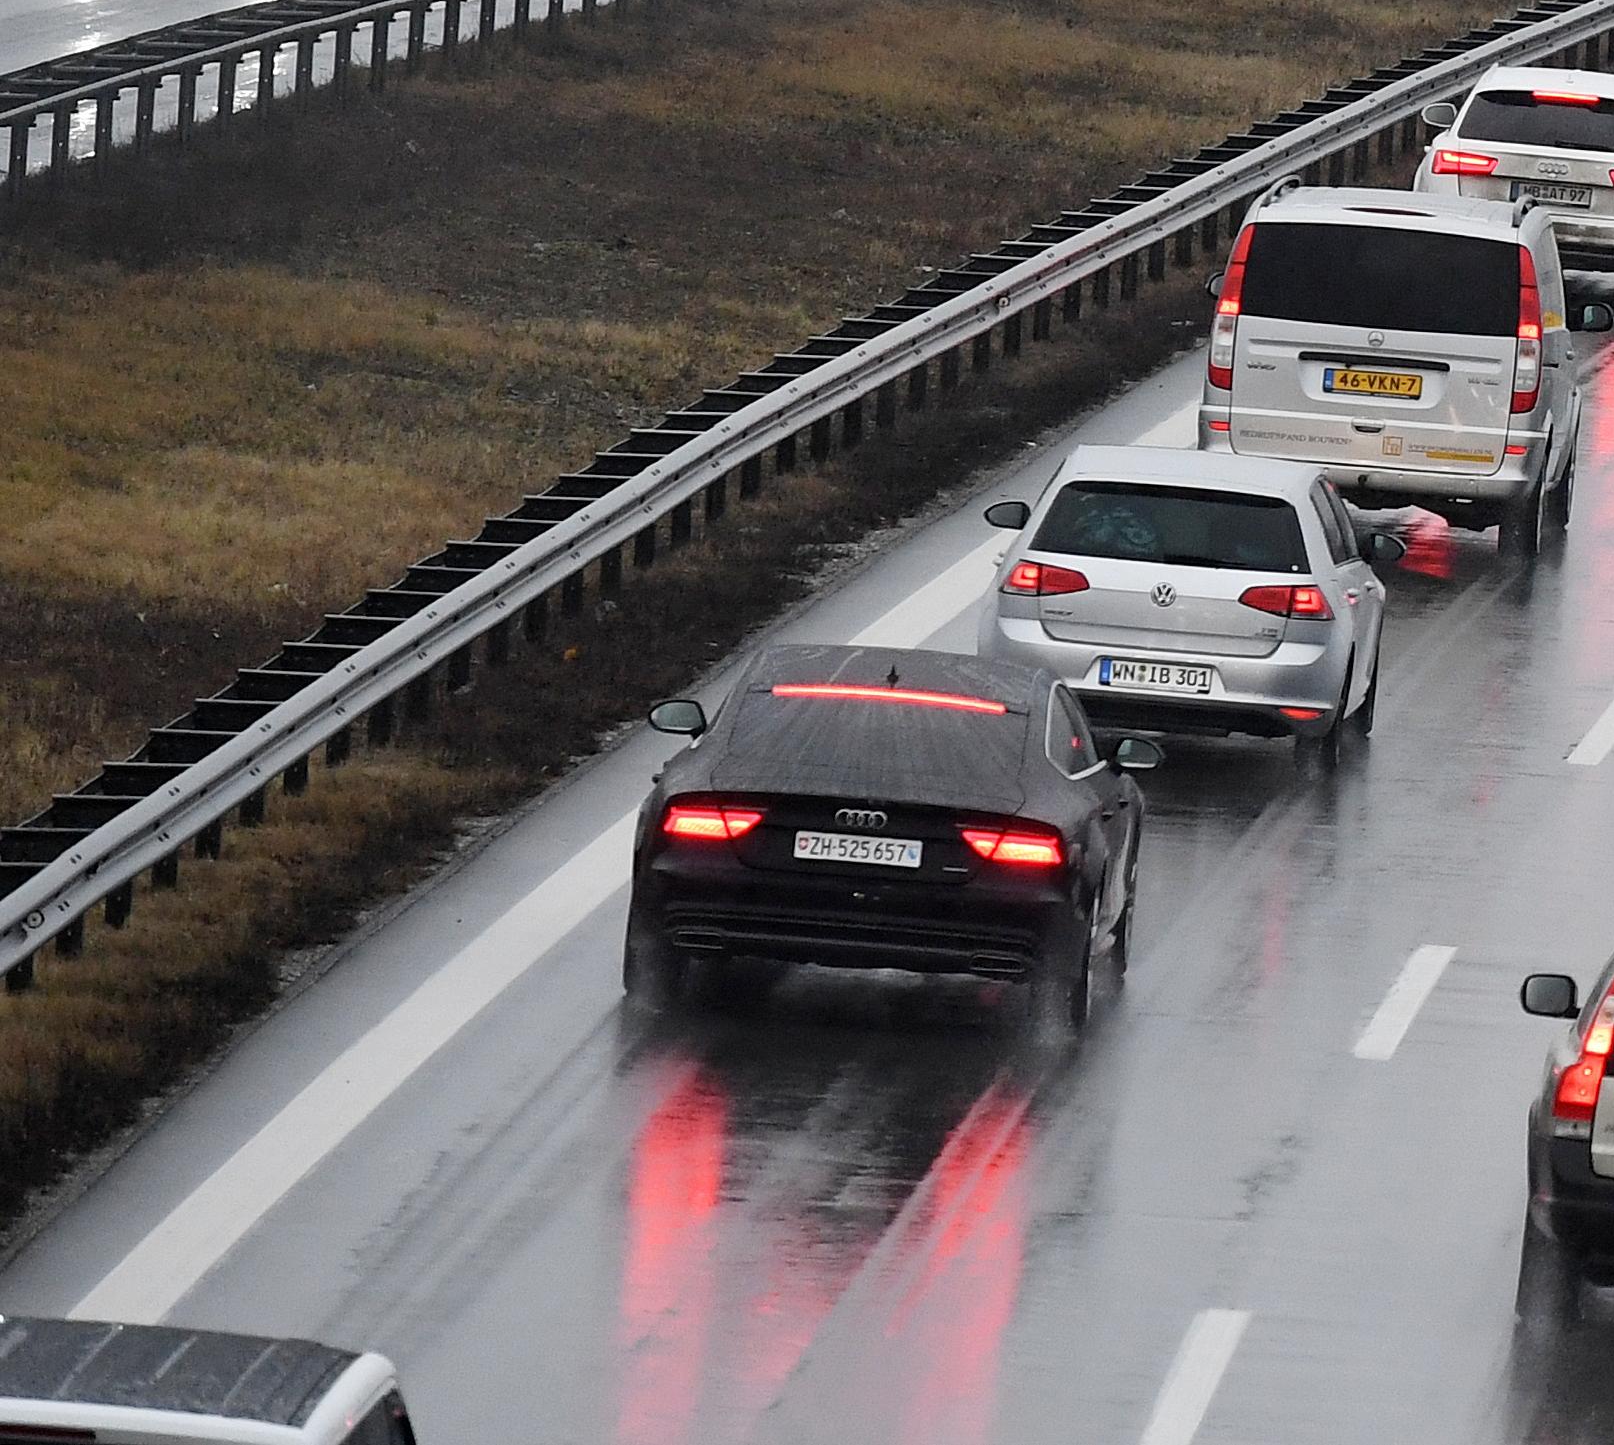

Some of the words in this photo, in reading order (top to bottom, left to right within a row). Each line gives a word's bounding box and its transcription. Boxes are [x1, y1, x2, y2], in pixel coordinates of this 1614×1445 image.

[1550, 187, 1565, 200] AT
[1571, 189, 1585, 202] 97
[1339, 373, 1417, 393] 46-VKN-7
[1112, 663, 1135, 681] WN
[1148, 666, 1170, 684] IB
[1175, 668, 1208, 688] 301
